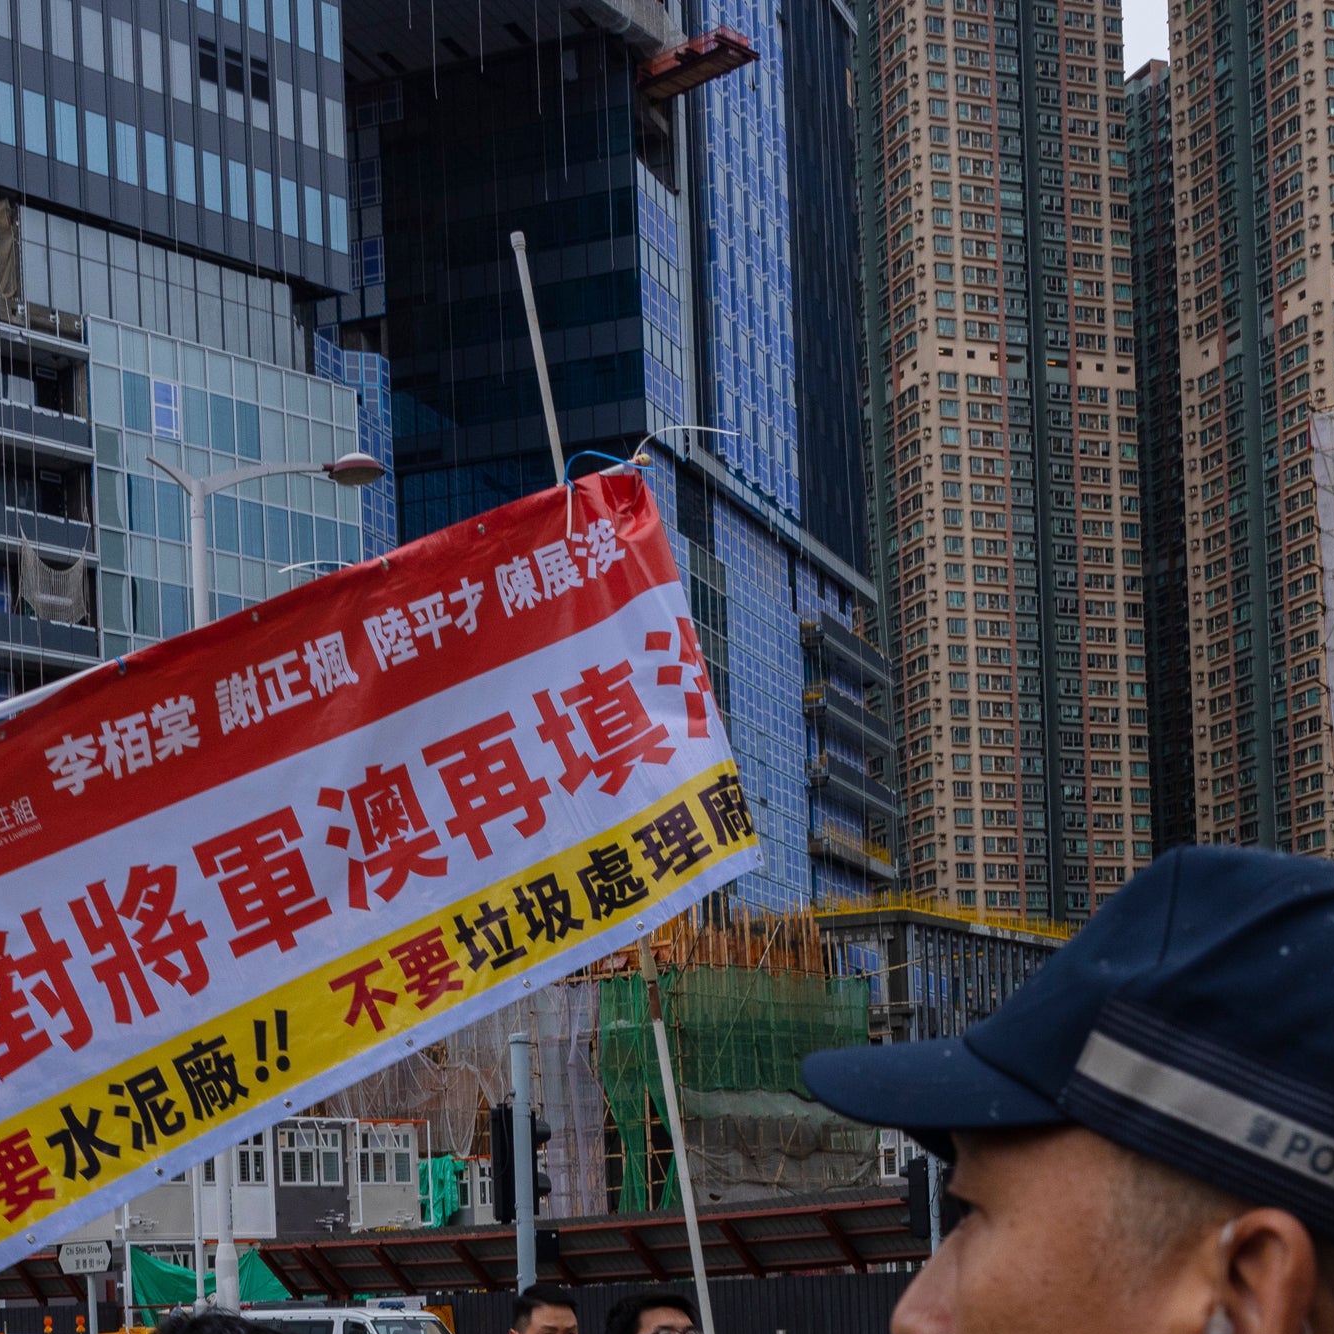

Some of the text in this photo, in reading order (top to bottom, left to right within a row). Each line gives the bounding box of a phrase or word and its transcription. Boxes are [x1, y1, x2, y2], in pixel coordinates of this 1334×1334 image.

[45, 694, 200, 796] 李栢棠
[214, 632, 359, 736] 謝正楓
[362, 578, 485, 673] 陸平才
[65, 1245, 103, 1256] Chi Shin Street
